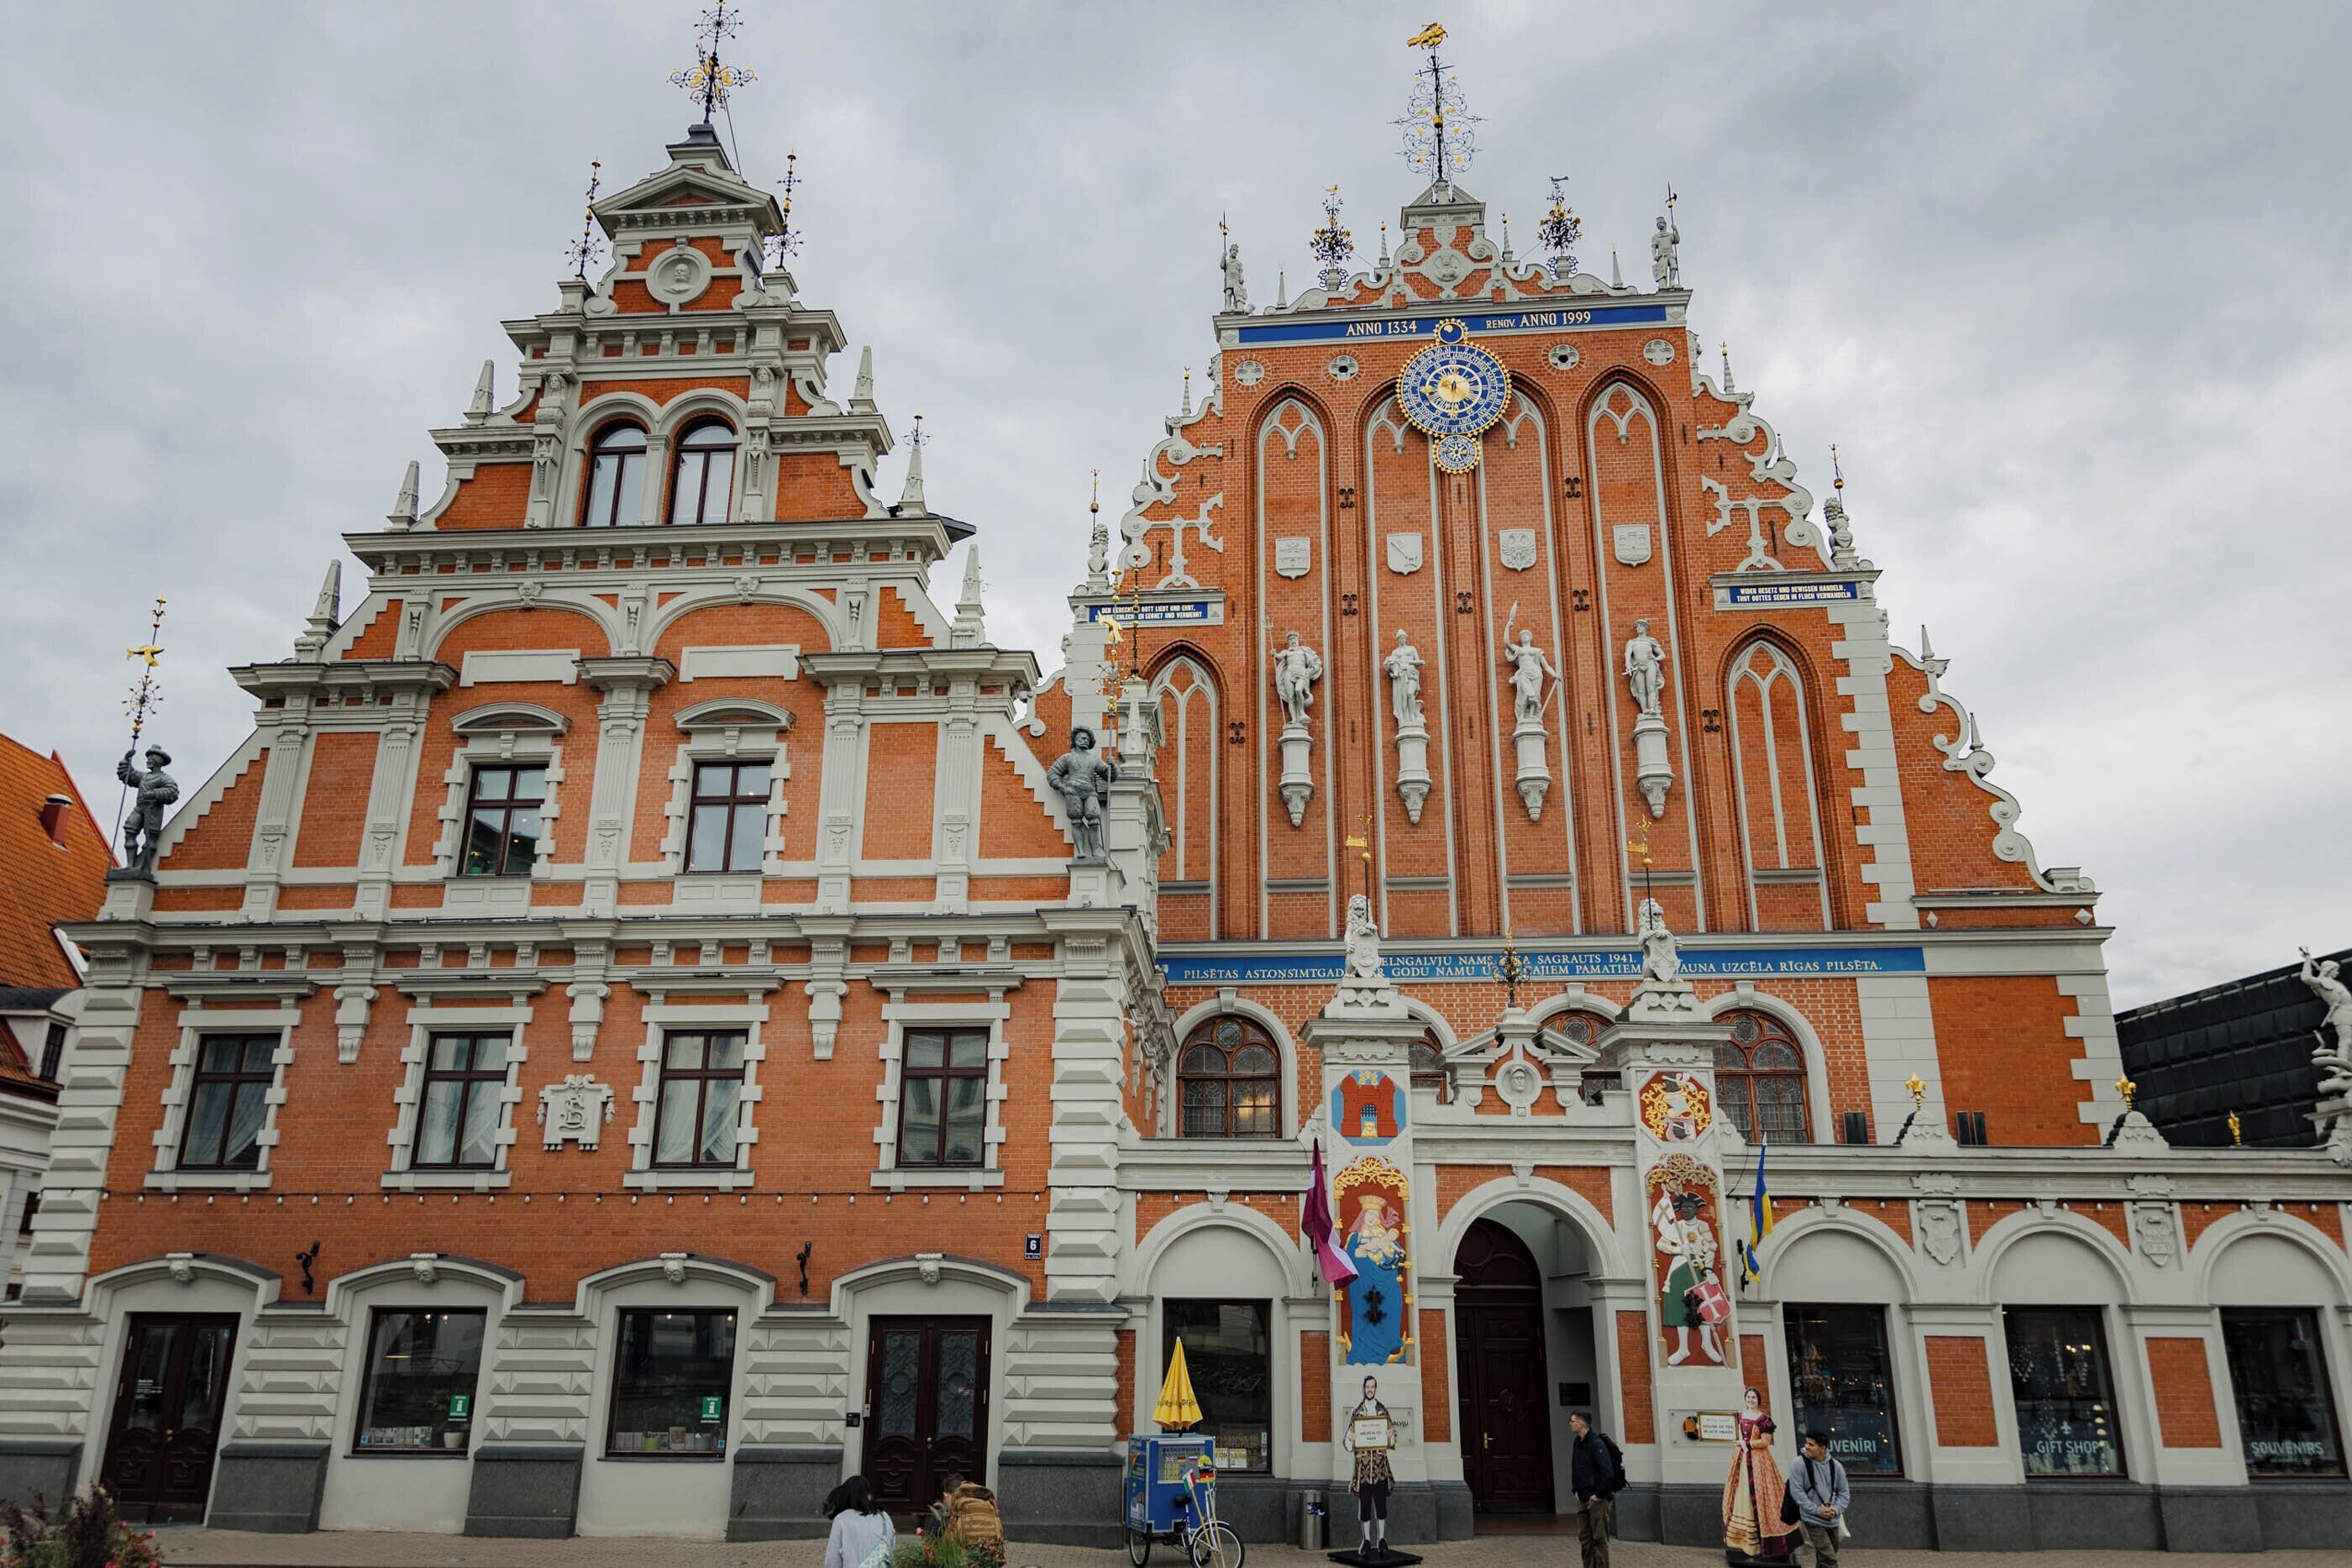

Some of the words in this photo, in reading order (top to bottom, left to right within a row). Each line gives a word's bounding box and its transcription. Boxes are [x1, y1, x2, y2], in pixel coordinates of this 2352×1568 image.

[1485, 318, 1515, 329] RENOV.
[1519, 312, 1557, 328] ANNO
[1562, 310, 1593, 326] 1999
[1346, 321, 1383, 337] ANNO
[1387, 320, 1418, 336] 1334
[1176, 611, 1203, 619] VERMEHRT
[1457, 956, 1493, 965] NAMS
[1537, 954, 1602, 965] SAGRAUTS
[1608, 953, 1637, 964] 1941.
[1184, 968, 1239, 979] PILSĒTAS
[1244, 966, 1346, 980] ASTOŅSIMTGAD
[1391, 967, 1430, 977] GODU
[1436, 966, 1475, 976] NAMU
[1576, 963, 1641, 975] PAMATIEM
[1722, 960, 1774, 973] UZCĒLA
[1780, 959, 1819, 972] RĪGAS
[1826, 958, 1882, 972] PILSĒTA.
[1030, 1240, 1037, 1251] 6
[1827, 1437, 1878, 1453] UVENĪRI
[2036, 1440, 2062, 1454] GIFT
[2065, 1440, 2099, 1454] SHOP
[2251, 1440, 2324, 1455] SOUVENIRS
